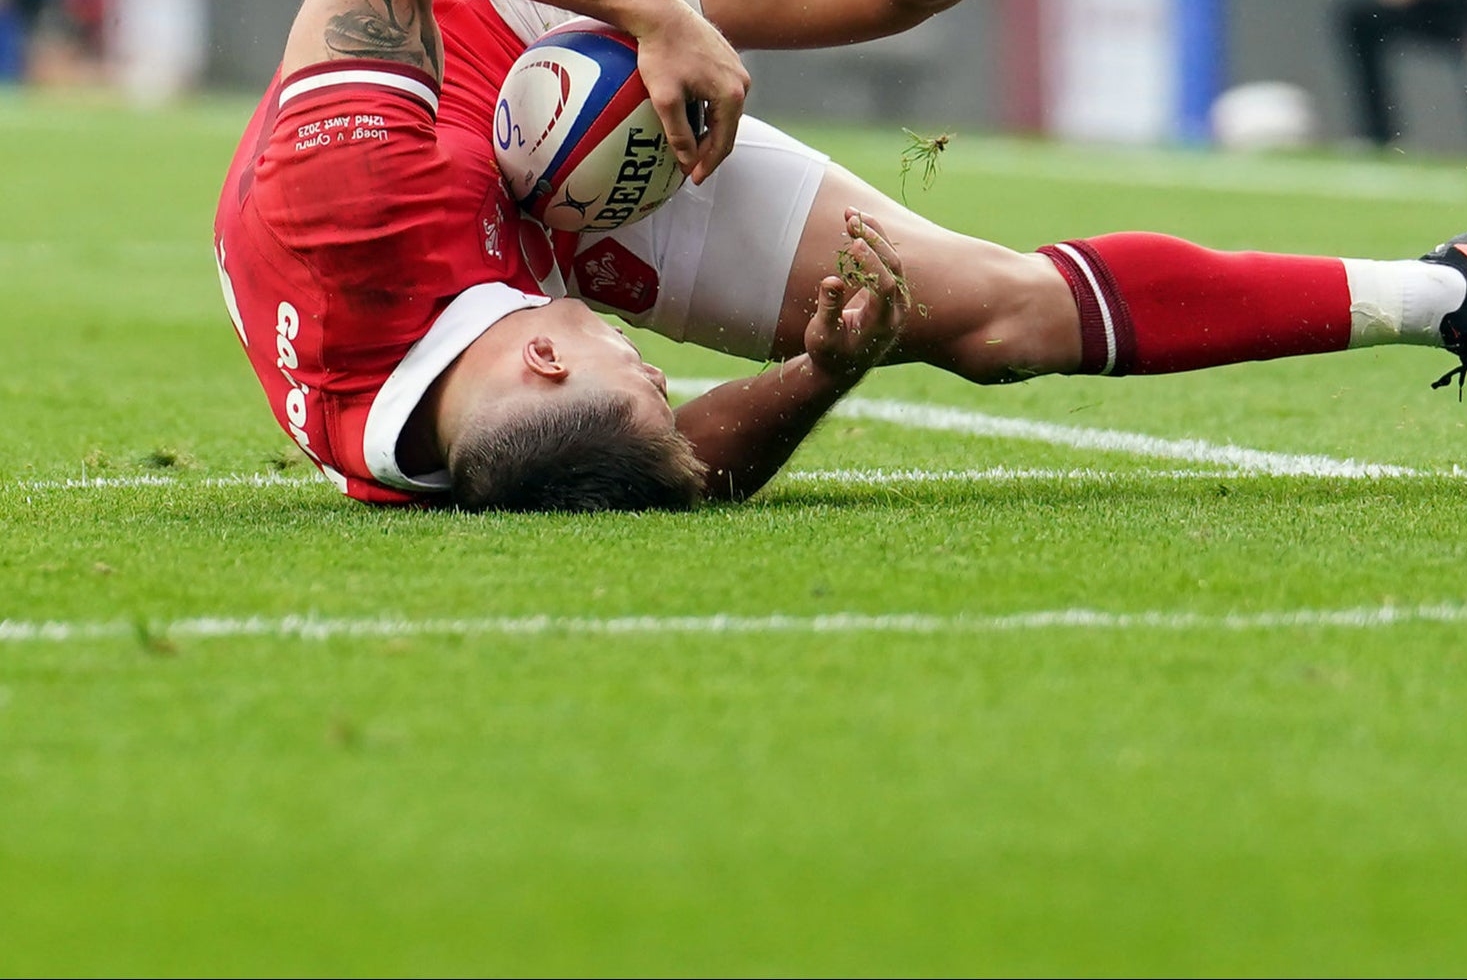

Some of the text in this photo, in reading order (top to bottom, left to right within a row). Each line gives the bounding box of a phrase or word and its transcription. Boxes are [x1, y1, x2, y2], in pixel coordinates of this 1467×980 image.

[295, 127, 388, 151] Lloegr v Cymru
[297, 114, 385, 138] 12fed Awst 2023
[496, 98, 526, 151] O2
[578, 127, 662, 233] LBERT
